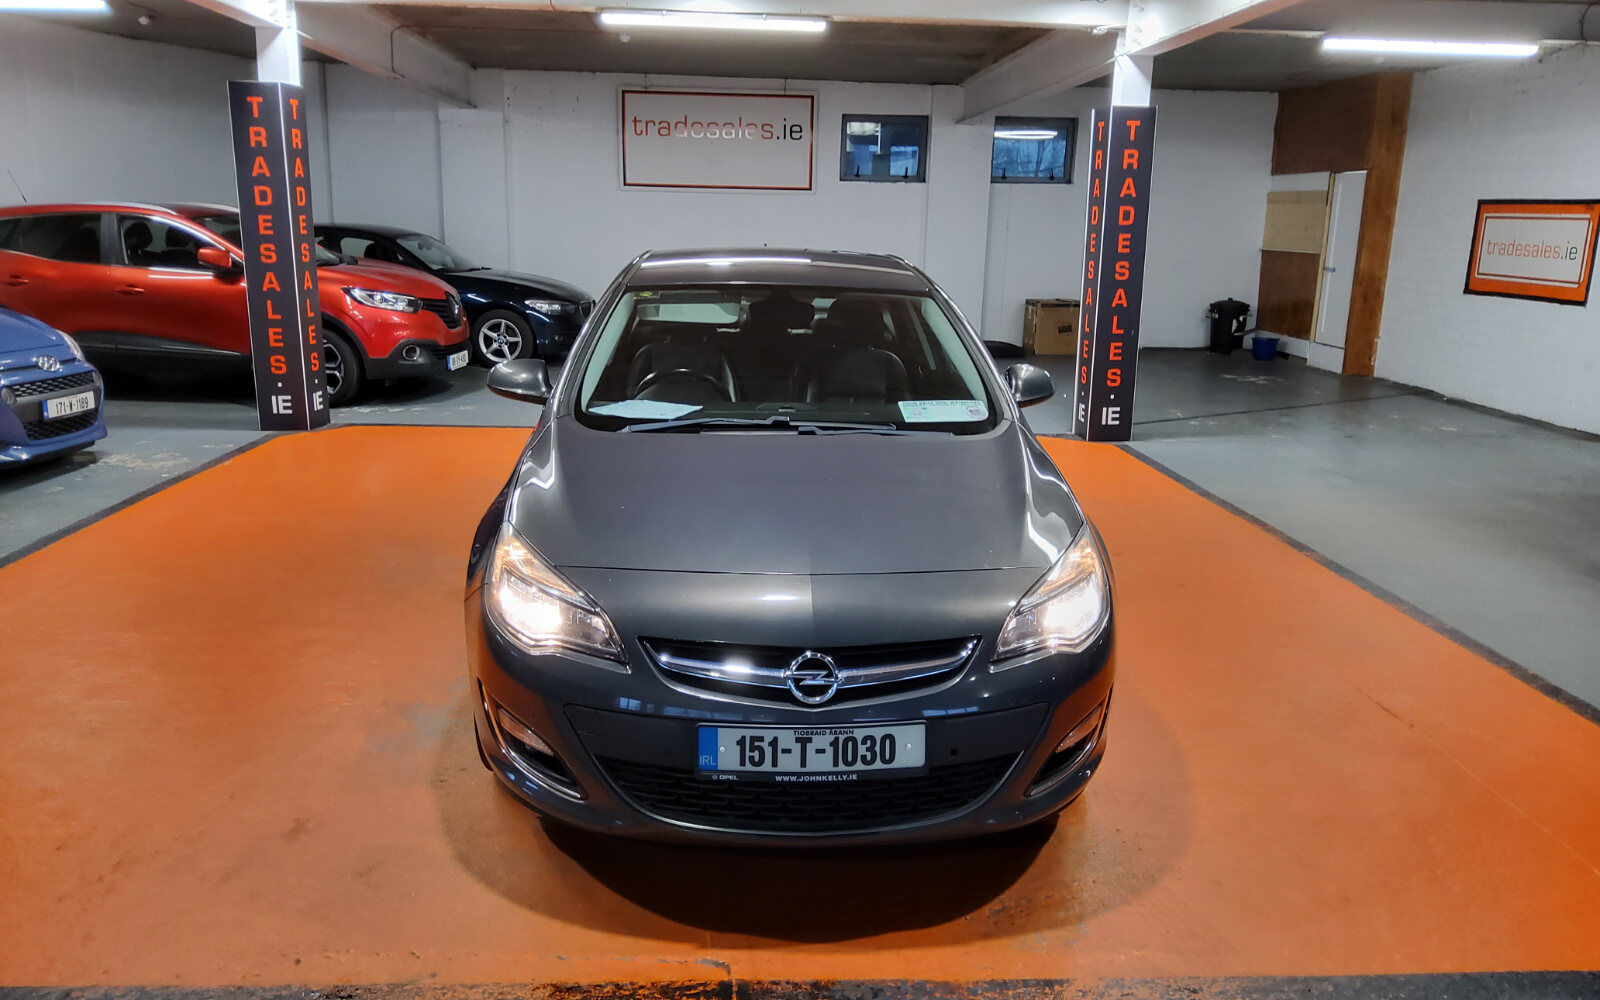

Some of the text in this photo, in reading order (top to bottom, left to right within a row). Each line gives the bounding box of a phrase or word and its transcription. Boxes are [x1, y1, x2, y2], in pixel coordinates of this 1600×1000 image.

[632, 115, 803, 141] tradesales.ie
[247, 96, 293, 415] TRADESALES.IE
[289, 98, 324, 411] TRADESALES.IE
[1487, 239, 1578, 261] tradesales.ie
[1078, 121, 1105, 423] TRADESALES.IE
[1101, 120, 1141, 426] TRADESALES.IE
[793, 729, 827, 737] TIOBRAID
[699, 755, 717, 766] IRL
[736, 733, 897, 769] 151-T-1030
[775, 773, 858, 783] WWW.JOHNKELLY.IE
